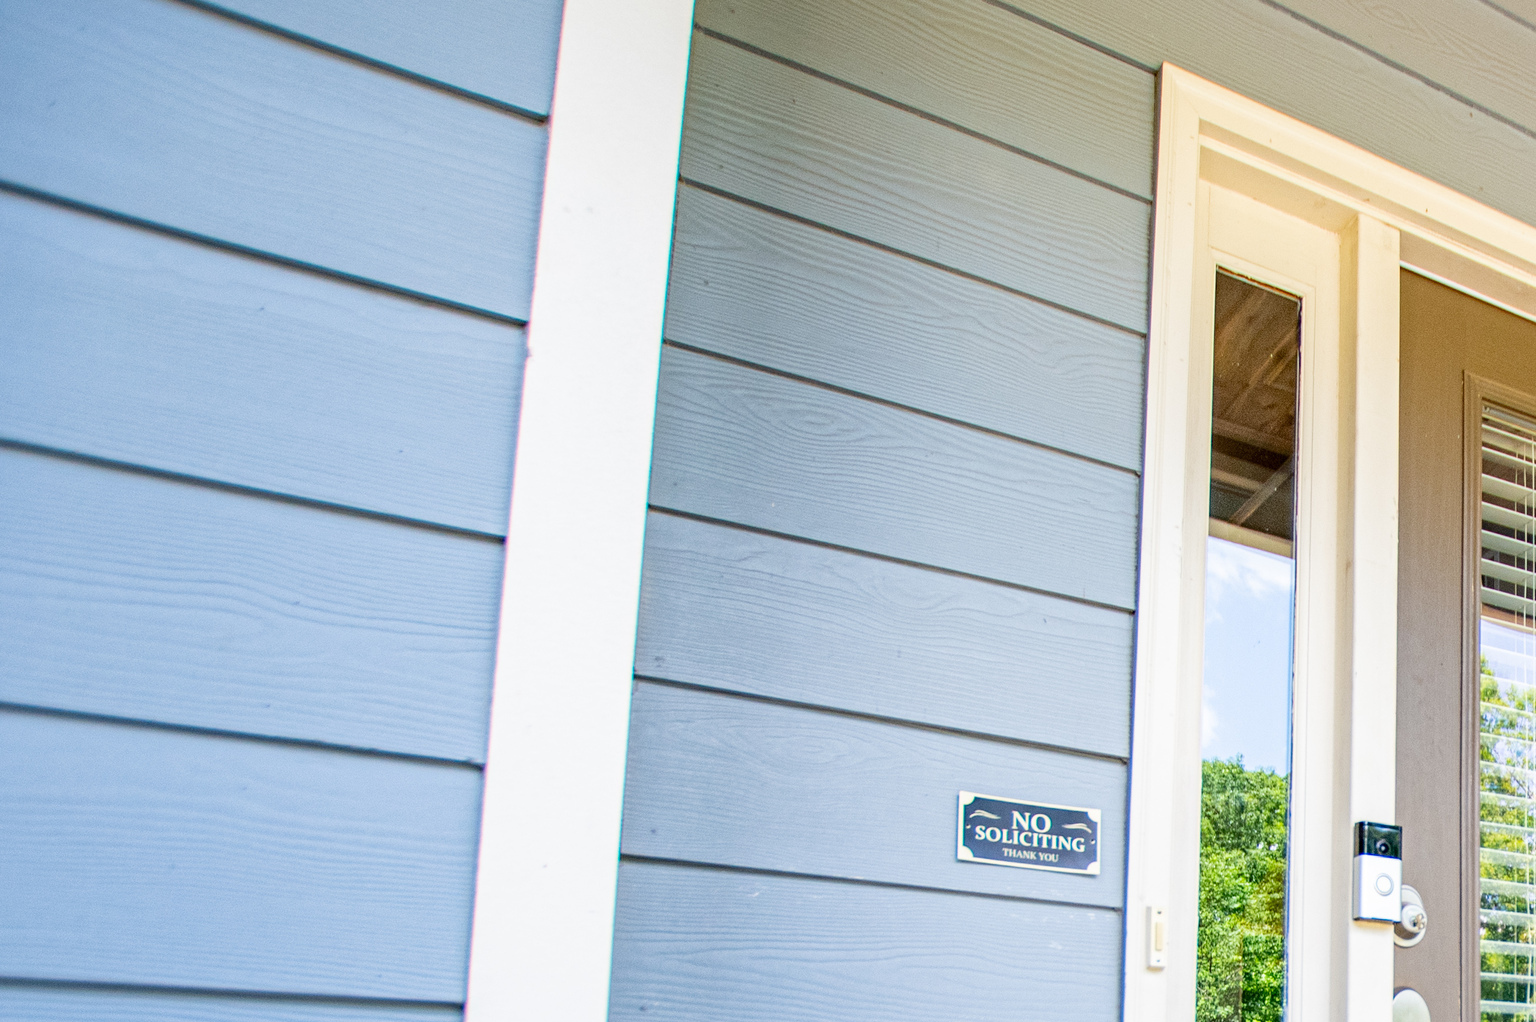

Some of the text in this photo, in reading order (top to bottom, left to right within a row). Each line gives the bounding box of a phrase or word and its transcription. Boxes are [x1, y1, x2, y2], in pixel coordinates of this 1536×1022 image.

[1011, 810, 1052, 833] NO
[975, 825, 1086, 853] SOLICITING
[1002, 847, 1059, 863] THANK YOU
